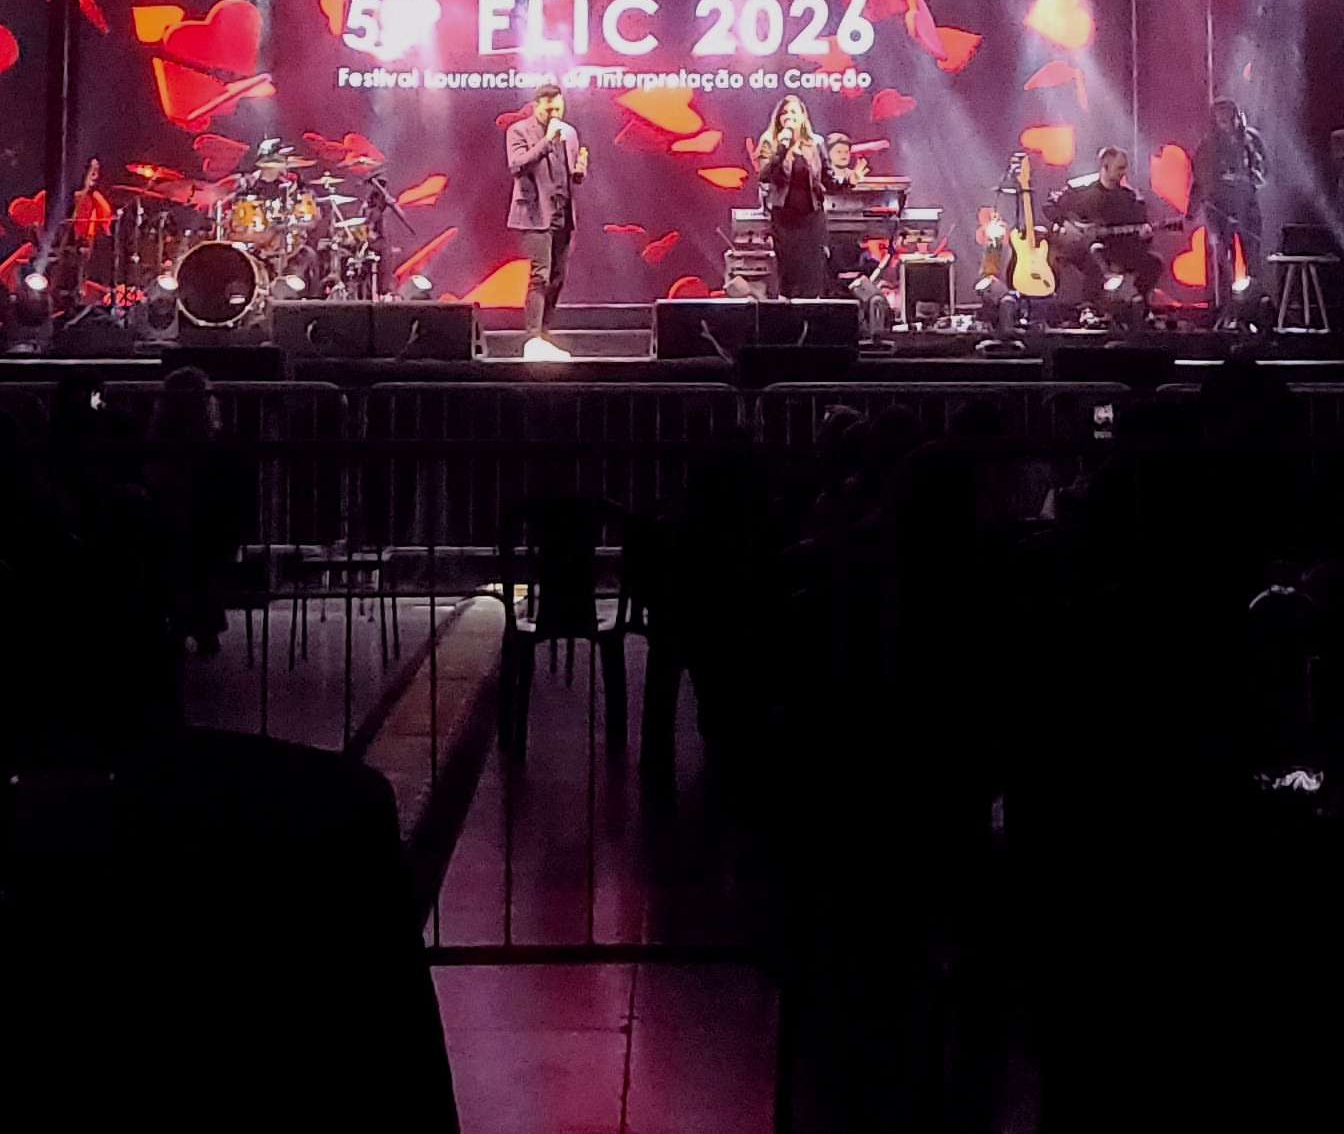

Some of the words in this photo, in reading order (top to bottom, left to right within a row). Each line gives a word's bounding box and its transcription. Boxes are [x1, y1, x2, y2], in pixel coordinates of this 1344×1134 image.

[337, 67, 419, 88] Festival
[749, 68, 779, 89] da
[783, 68, 872, 92] Canção
